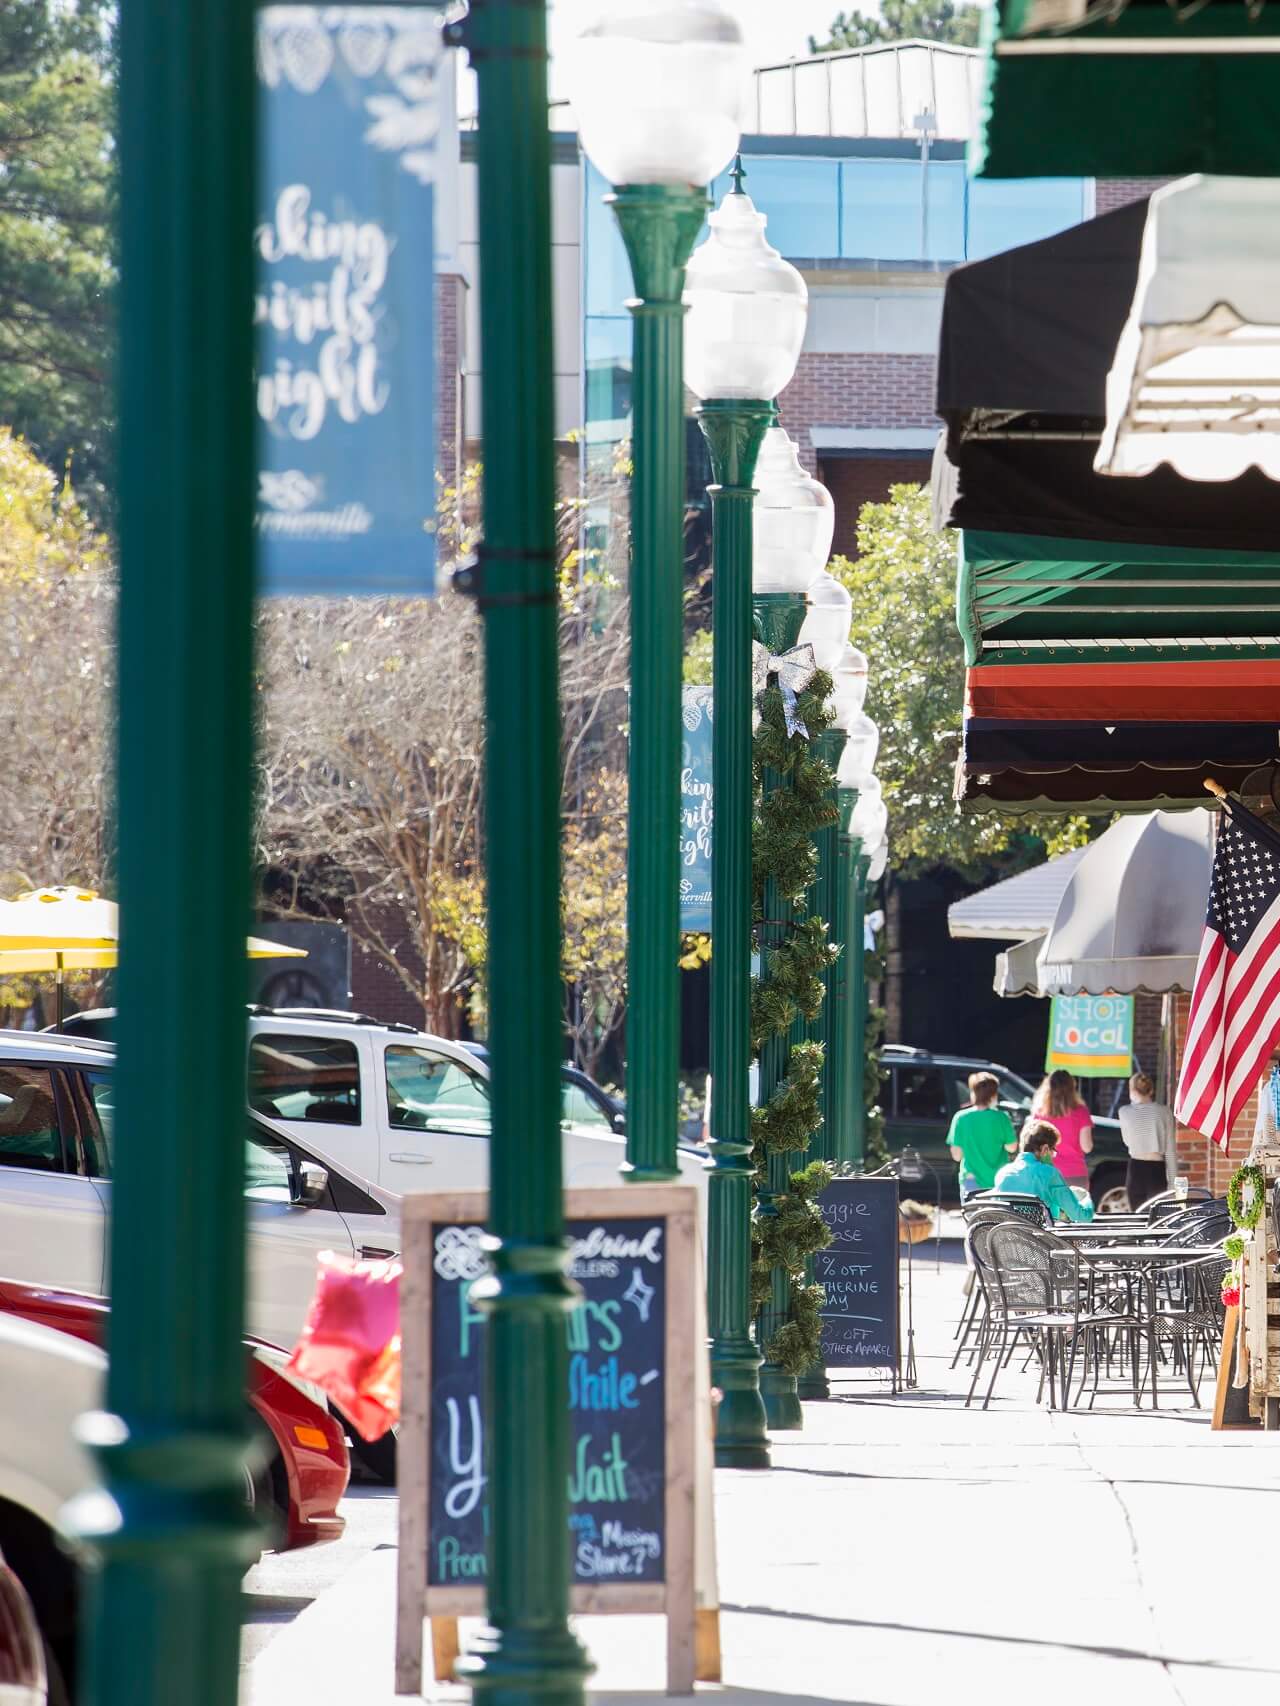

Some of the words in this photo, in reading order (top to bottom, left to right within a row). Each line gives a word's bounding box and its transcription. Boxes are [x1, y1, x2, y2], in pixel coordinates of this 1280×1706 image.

[1059, 999, 1128, 1021] SHOP
[819, 1204, 871, 1225] aggie
[841, 1264, 872, 1276] OFF
[822, 1281, 879, 1293] THERINE
[843, 1327, 873, 1339] OFF
